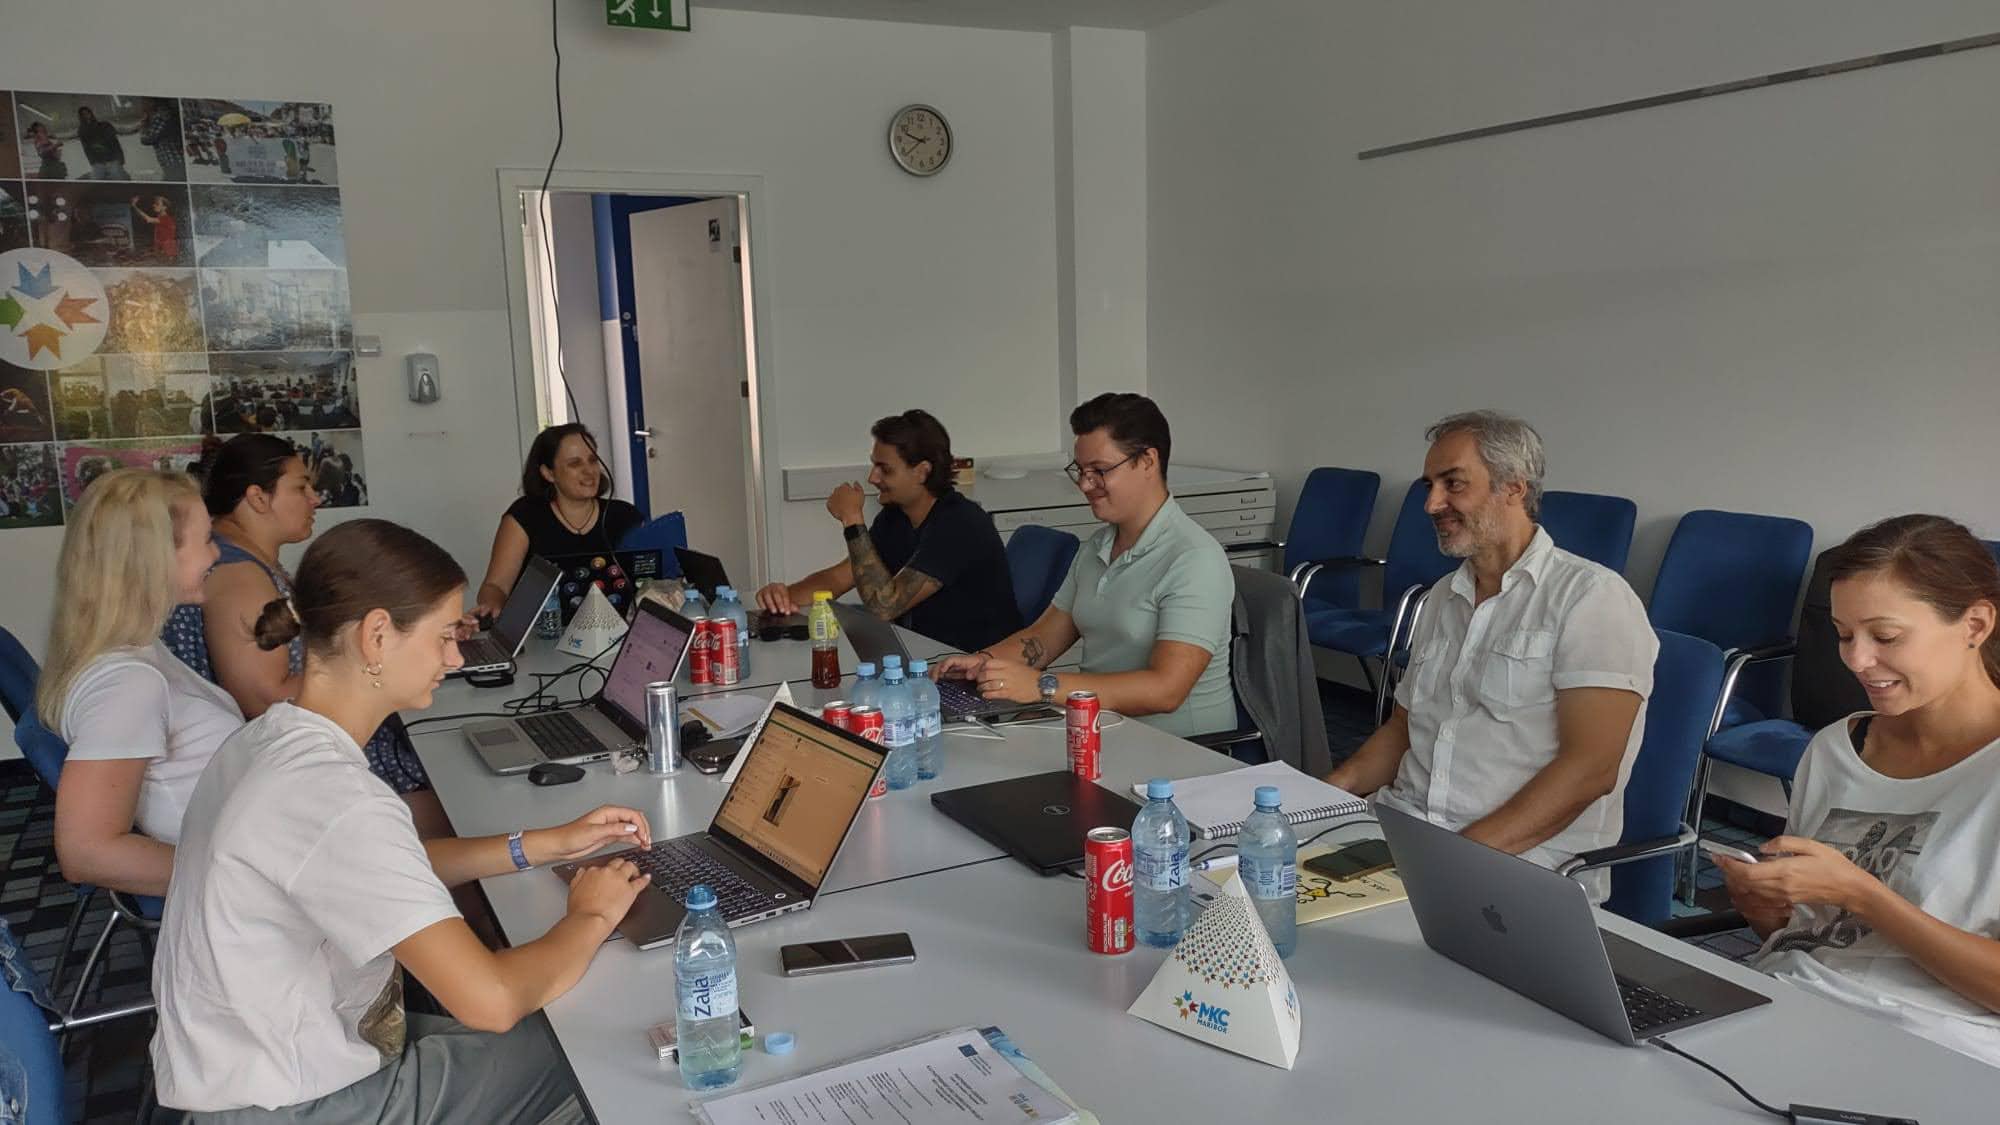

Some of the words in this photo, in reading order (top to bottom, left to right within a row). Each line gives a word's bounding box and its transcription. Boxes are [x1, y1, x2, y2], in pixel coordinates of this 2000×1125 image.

[1169, 852, 1181, 888] Zala
[693, 976, 711, 1017] Zala
[1196, 1018, 1228, 1035] MARIBOR
[1198, 1002, 1231, 1027] MKC
